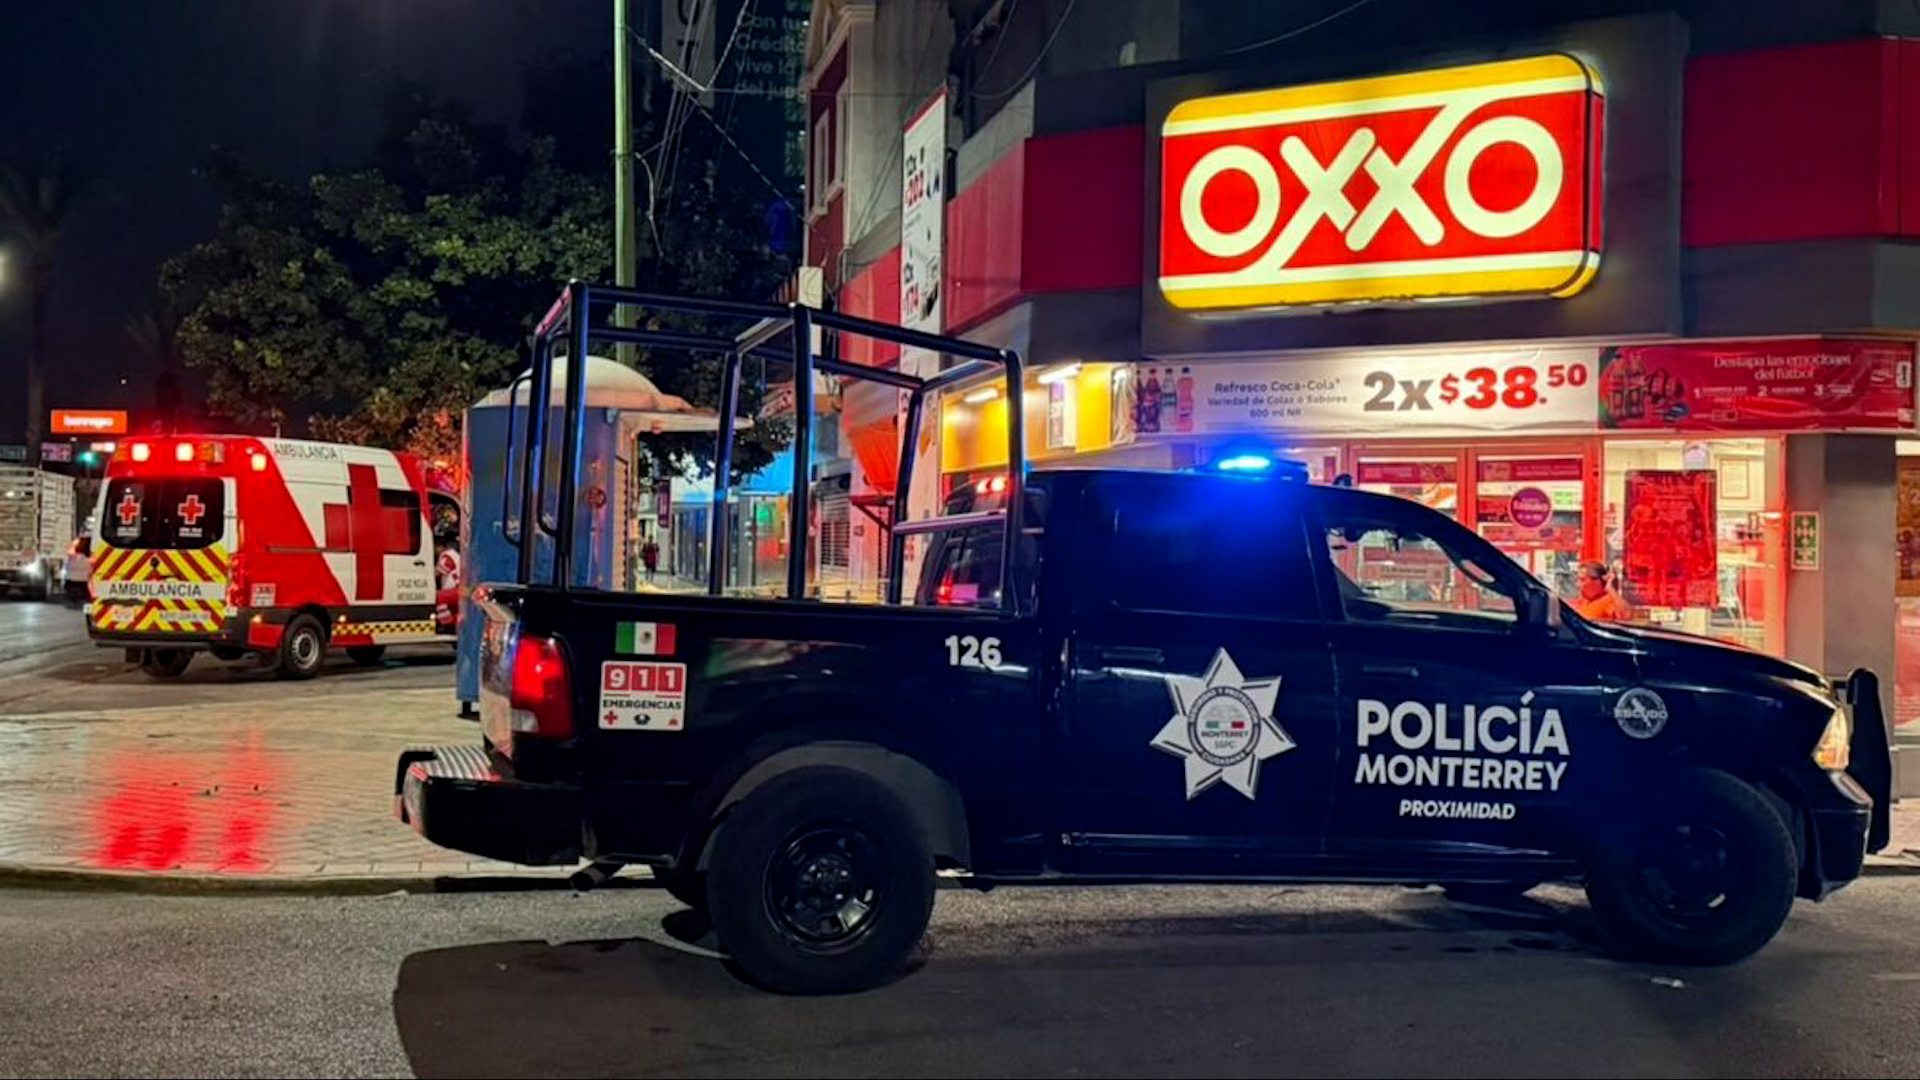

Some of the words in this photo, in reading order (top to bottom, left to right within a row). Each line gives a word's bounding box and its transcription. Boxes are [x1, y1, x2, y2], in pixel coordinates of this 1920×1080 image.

[1180, 112, 1564, 262] OXXO
[1715, 355, 1765, 369] Destapa
[1754, 368, 1775, 380] del
[1214, 382, 1268, 393] Refresco
[1253, 396, 1264, 405] de
[274, 443, 338, 459] AMBULANCIA
[109, 583, 202, 595] AMBULANCIA
[945, 635, 1003, 668] 126
[609, 667, 676, 690] 911
[602, 700, 682, 710] EMERGENCIAS
[1357, 690, 1570, 755] POLICÍA
[1354, 753, 1567, 791] MONTERREY
[1399, 800, 1516, 819] PROXIMIDAD
